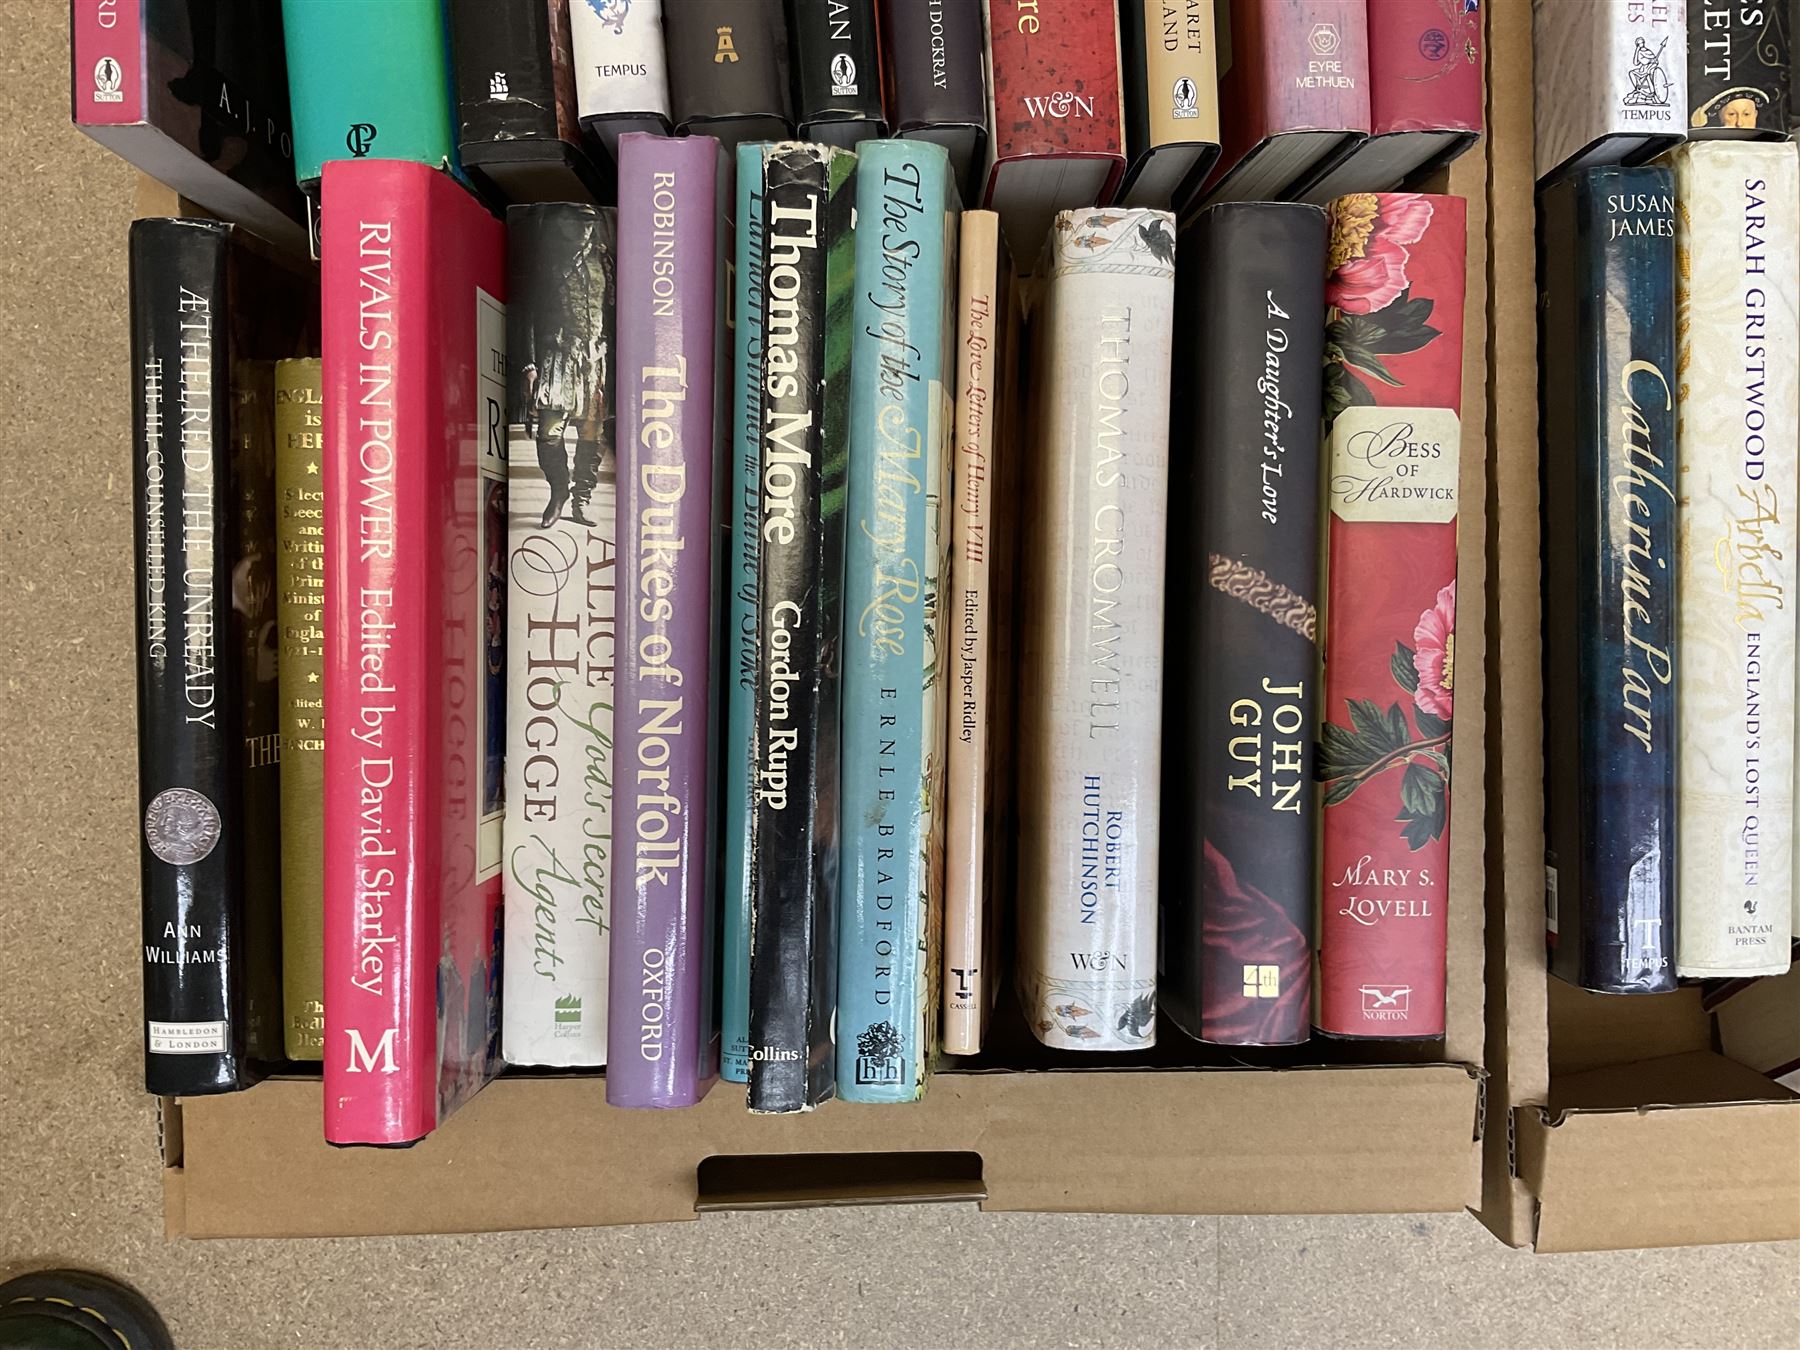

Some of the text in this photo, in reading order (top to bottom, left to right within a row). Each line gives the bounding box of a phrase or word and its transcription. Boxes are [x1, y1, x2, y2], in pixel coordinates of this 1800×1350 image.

[1651, 0, 1667, 28] EL
[1704, 0, 1731, 80] ETT
[595, 64, 647, 77] TEMPUS
[929, 11, 947, 90] DOCKRAY
[1296, 76, 1354, 88] METHUEN
[1309, 61, 1342, 72] EYRE
[95, 92, 121, 101] SUTTON
[833, 86, 857, 95] SUTTON
[1024, 91, 1094, 118] W&N
[1174, 108, 1197, 118] SUTTON
[1622, 110, 1671, 121] TEMPUS
[1608, 194, 1674, 213] SUSAN
[1609, 219, 1674, 241] JAMES
[1745, 178, 1766, 482] SARAH GRISTWOOD
[145, 358, 163, 404] THE
[763, 194, 818, 546] Thomas More
[305, 410, 322, 426] is
[859, 163, 924, 656] The Story of the Mary Rose
[960, 295, 989, 564] The Love Letters of Henry VIII
[1257, 290, 1292, 525] A Daughter's Love
[1396, 464, 1419, 477] OF
[182, 485, 215, 552] THE
[635, 172, 688, 888] ROBINSON The Dukes of Norfolk
[1088, 306, 1132, 741] THOMAS CROMWELL
[1616, 359, 1676, 754] Catherine Parr
[1734, 484, 1783, 632] Arbella
[148, 602, 168, 659] KING
[304, 610, 322, 621] of
[352, 221, 397, 998] RIVALS IN POWER Edited by David Starkey
[586, 529, 615, 687] ALICE
[183, 567, 217, 730] UNREADY
[960, 590, 978, 744] Edited by Jasper Ridley
[760, 600, 801, 812] Gordon Rupp
[1228, 698, 1262, 797] GUY
[1263, 677, 1303, 815] JOHN
[1742, 631, 1761, 887] ENGLAND'S LOST QUEEN
[575, 818, 612, 936] Secret
[875, 687, 897, 1007] ERNLE BRADFORD
[1080, 775, 1101, 925] HUTCHINSON
[1105, 810, 1123, 891] ROBERT
[1419, 869, 1435, 887] S.
[511, 835, 582, 981] Agents
[1728, 924, 1773, 935] BANTAM
[1735, 935, 1767, 946] PRESS
[1070, 950, 1127, 971] W&N
[153, 1026, 218, 1037] HAMBLEDON
[641, 948, 664, 1062] OXFORD
[950, 1002, 977, 1010] CASSLL
[1363, 1011, 1407, 1020] NORTON
[154, 1039, 218, 1050] & LONDON
[345, 1028, 400, 1072] M
